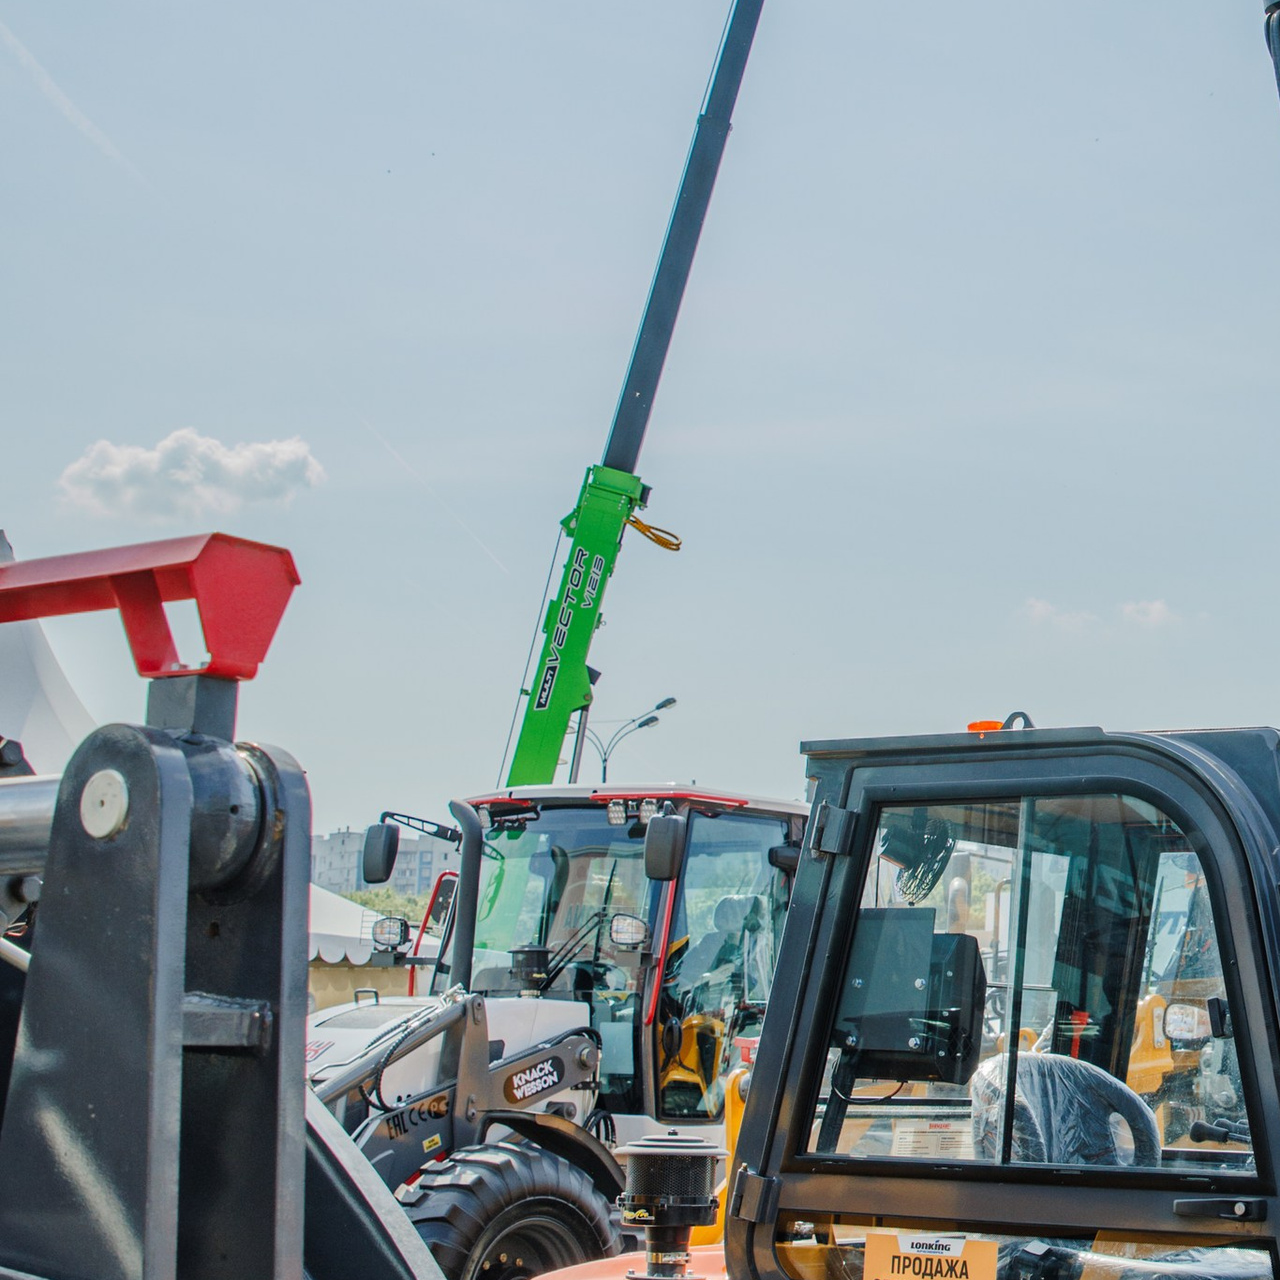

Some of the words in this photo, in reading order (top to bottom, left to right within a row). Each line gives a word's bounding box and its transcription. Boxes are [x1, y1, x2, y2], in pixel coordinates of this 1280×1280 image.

[547, 547, 589, 663] VECTOR
[540, 669, 555, 705] MULTI
[511, 1059, 554, 1088] KNACK
[512, 1071, 559, 1100] WESSON
[891, 1255, 969, 1279] ПРОДАЖА
